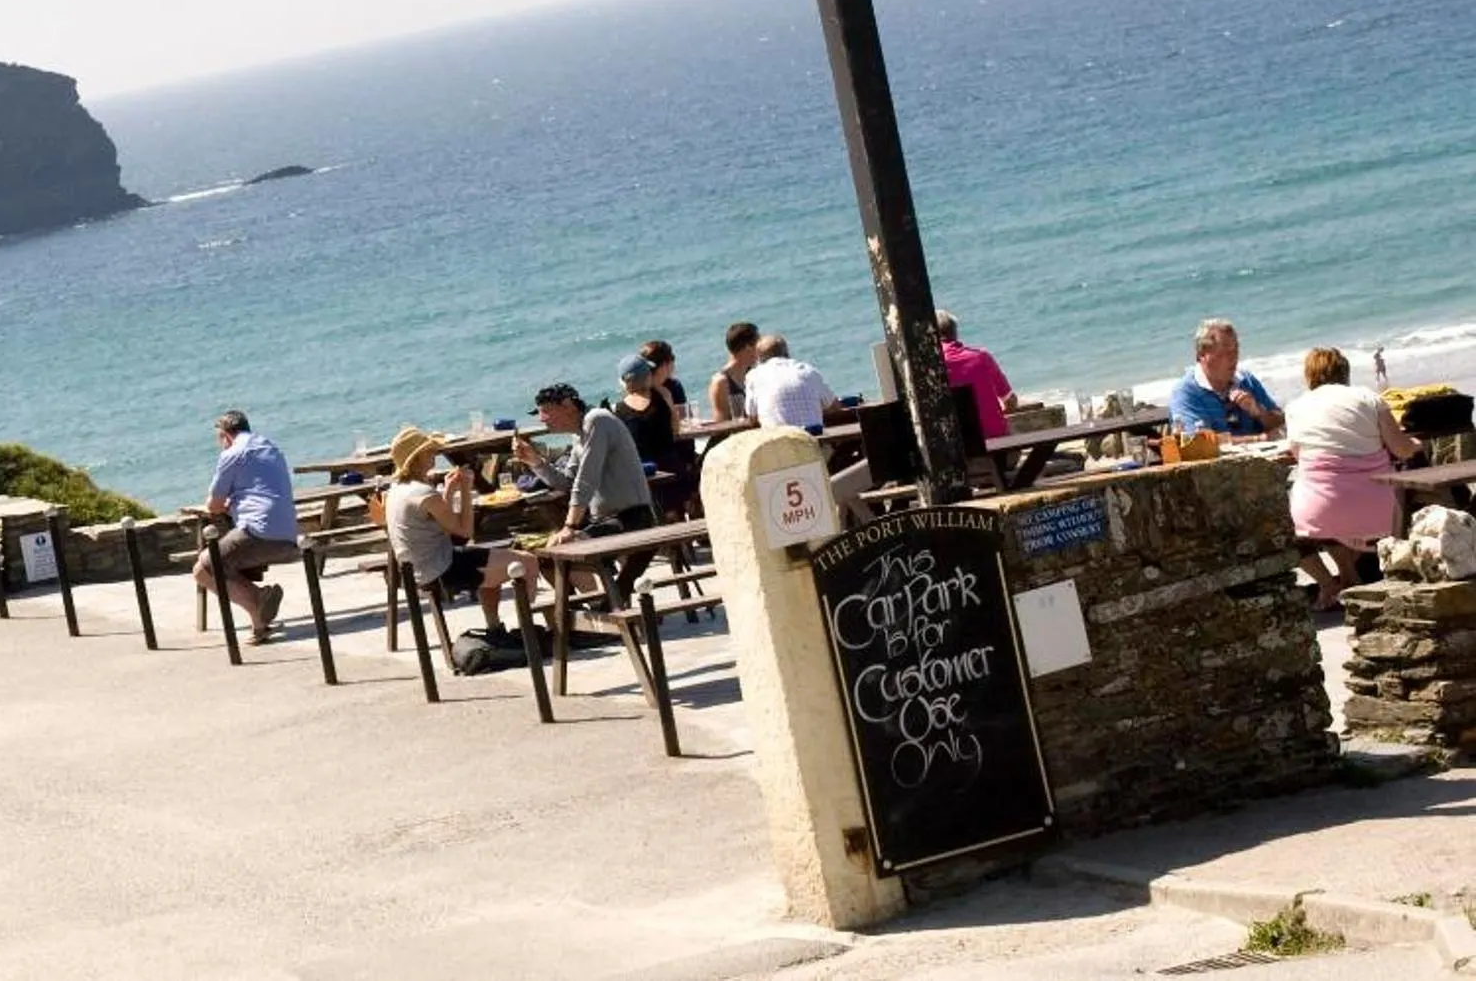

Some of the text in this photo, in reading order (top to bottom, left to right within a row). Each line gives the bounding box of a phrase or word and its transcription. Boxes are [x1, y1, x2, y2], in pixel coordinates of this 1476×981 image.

[782, 505, 816, 525] MPH
[785, 480, 804, 508] 5
[814, 511, 994, 571] THE PORT WILLIAM
[860, 543, 936, 597] This
[833, 566, 981, 650] Car Park
[911, 614, 951, 658] for
[853, 645, 995, 723] Customer
[899, 693, 968, 742] Use
[890, 728, 984, 789] Only
